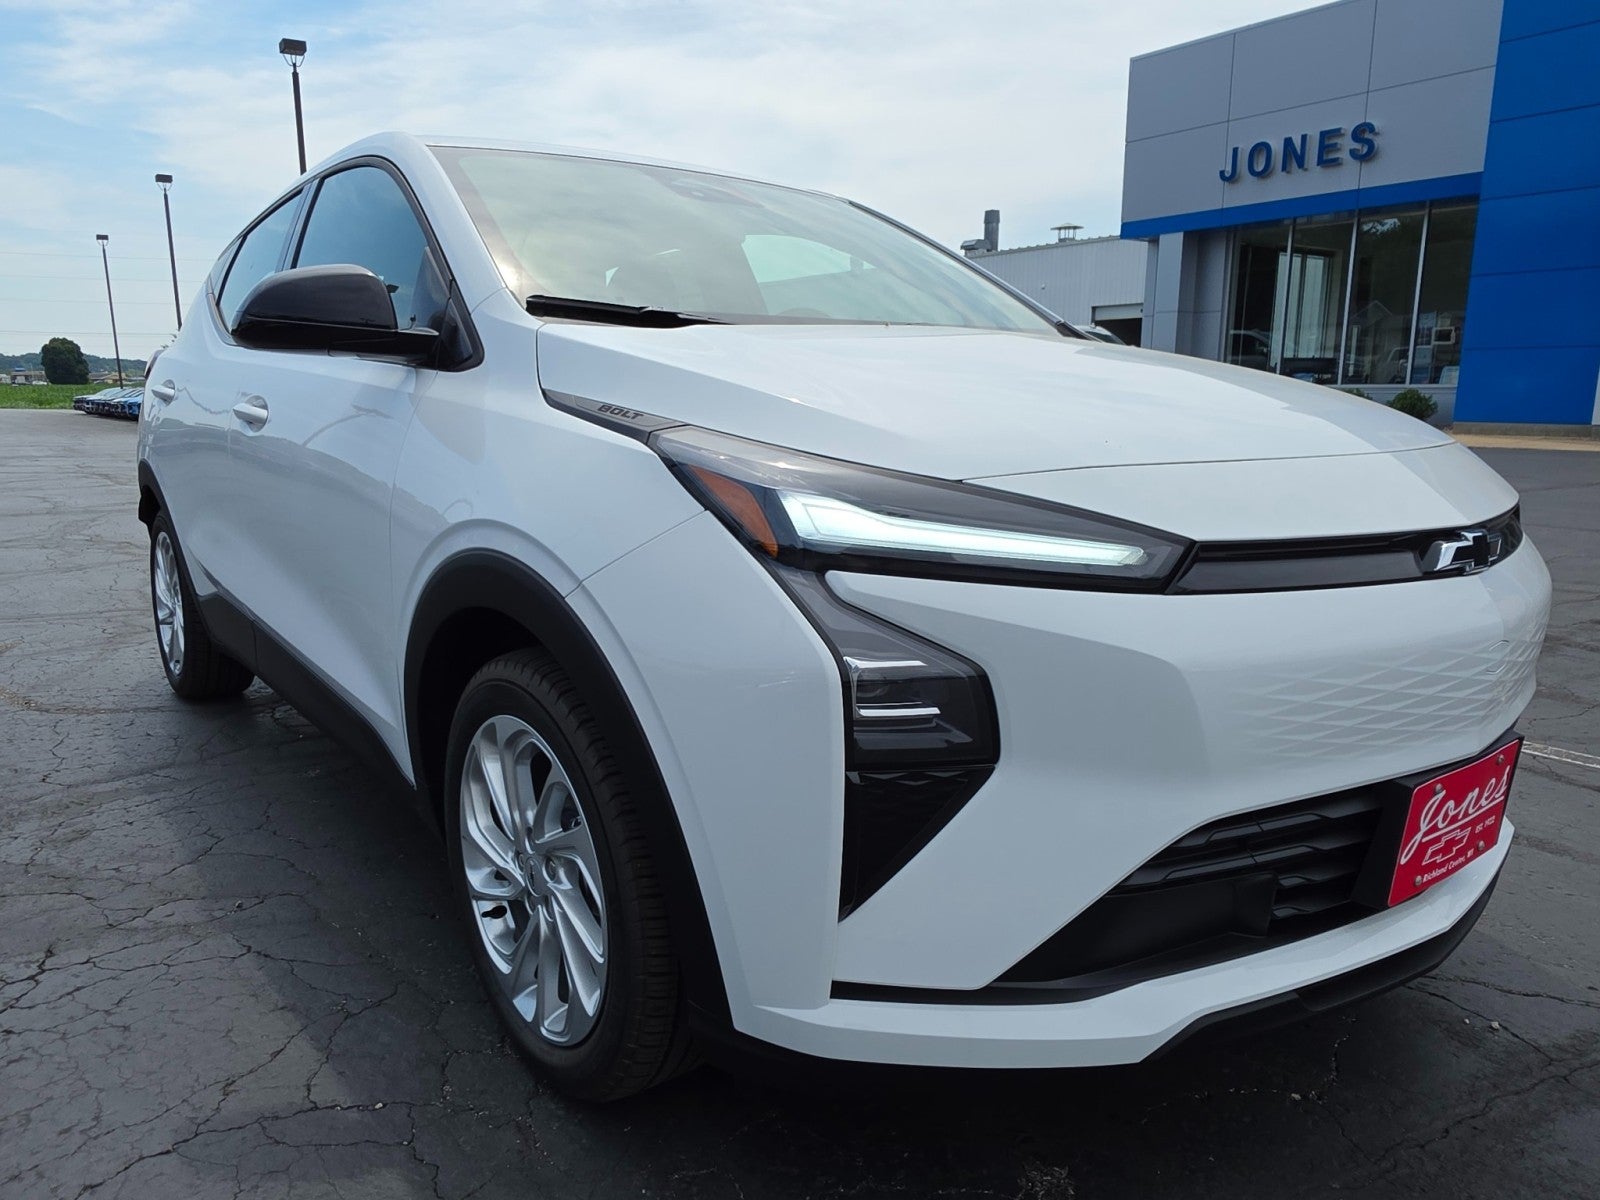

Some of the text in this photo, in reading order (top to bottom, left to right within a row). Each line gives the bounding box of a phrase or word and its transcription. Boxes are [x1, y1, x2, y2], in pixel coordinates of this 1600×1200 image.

[1219, 121, 1378, 183] JONES
[597, 404, 645, 420] BOLT
[1400, 765, 1511, 865] Jones
[1423, 863, 1449, 883] Richland
